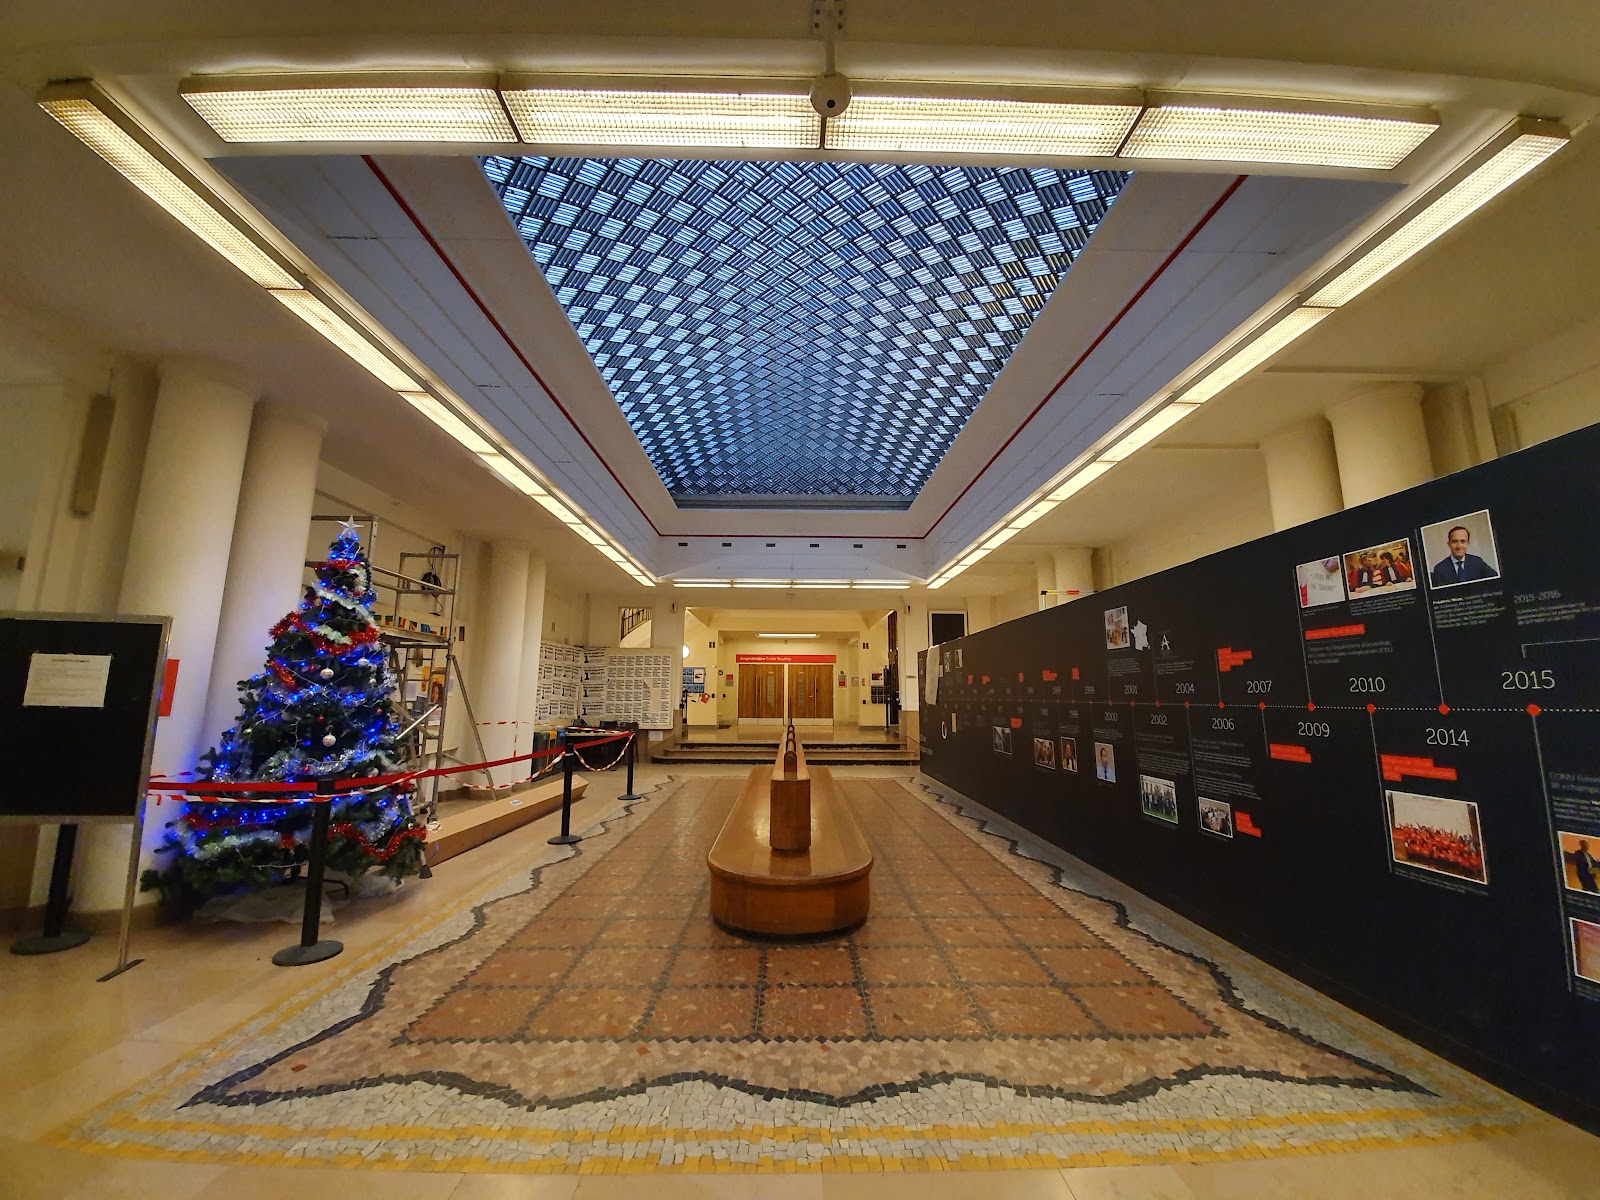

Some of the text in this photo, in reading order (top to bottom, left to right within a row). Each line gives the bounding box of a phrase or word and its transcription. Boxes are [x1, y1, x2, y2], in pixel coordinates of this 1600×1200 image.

[1246, 680, 1273, 693] 2007
[1348, 676, 1386, 693] 2010
[1501, 669, 1556, 690] 2015
[1175, 683, 1195, 694] 2004
[1104, 711, 1119, 722] 2000
[1150, 714, 1168, 726] 2002
[1211, 717, 1235, 731] 2006
[1297, 721, 1330, 737] 2009
[1425, 727, 1470, 747] 2014
